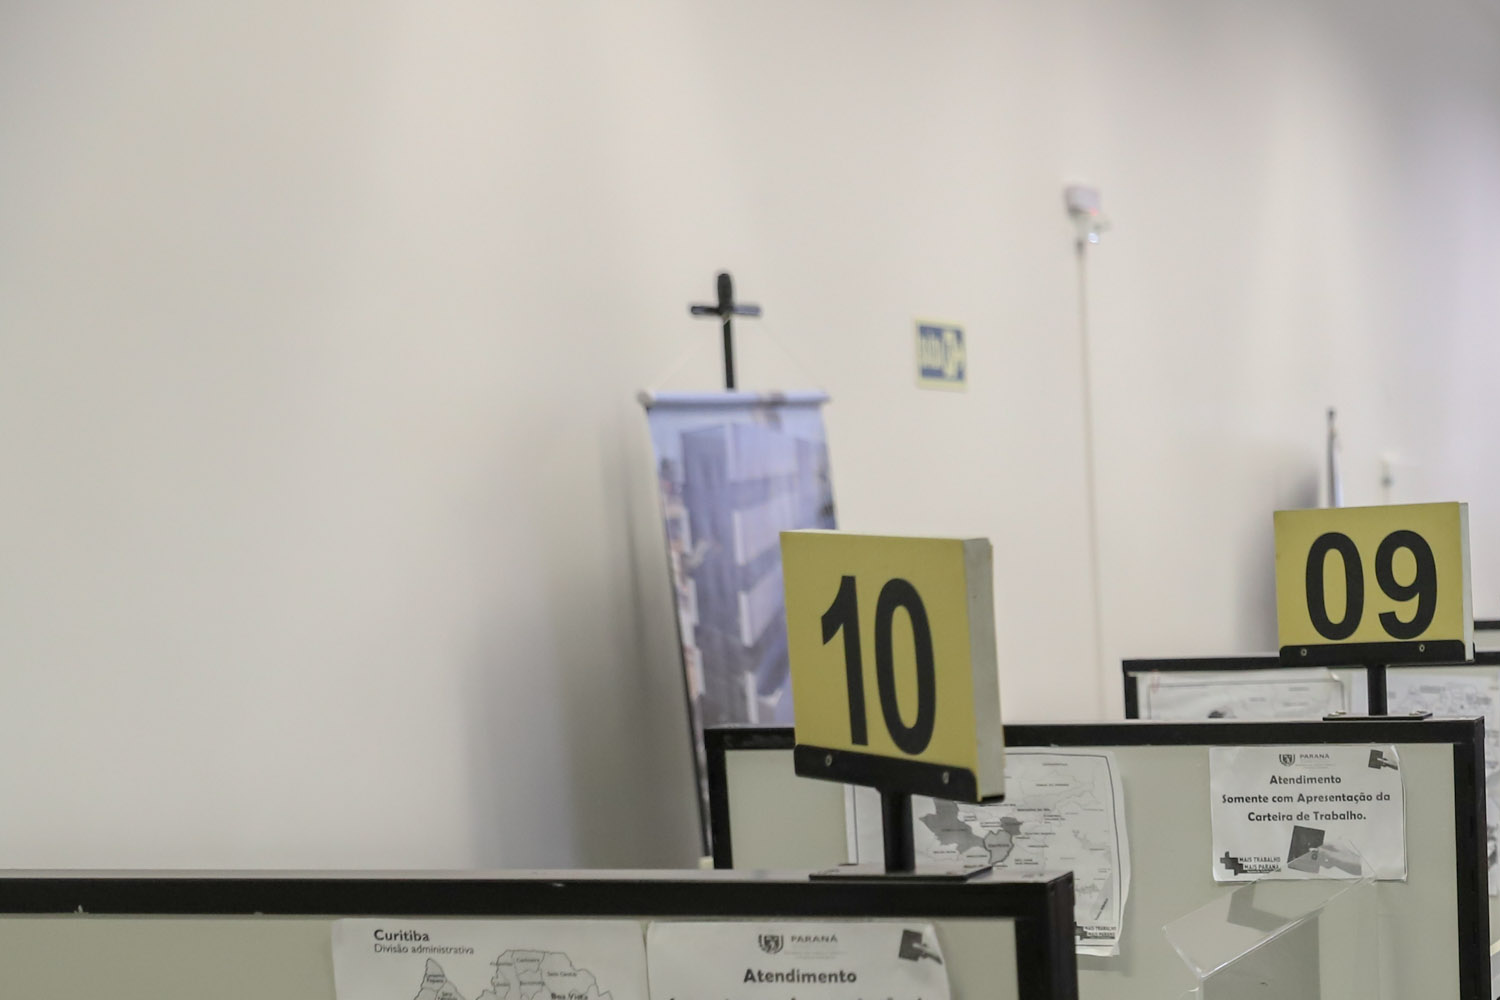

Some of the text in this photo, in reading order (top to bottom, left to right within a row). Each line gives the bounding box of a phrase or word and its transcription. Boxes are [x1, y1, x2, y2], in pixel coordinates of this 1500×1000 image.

[1304, 530, 1438, 641] 09
[820, 575, 937, 755] 10
[1269, 775, 1342, 785] Atendimento
[1222, 791, 1391, 805] Somente com Apresentação da
[1247, 810, 1367, 822] Carteira de Trabalho.
[374, 929, 430, 942] Curitiba
[374, 943, 474, 954] Divisão administrativa
[743, 968, 857, 983] Atendimento
